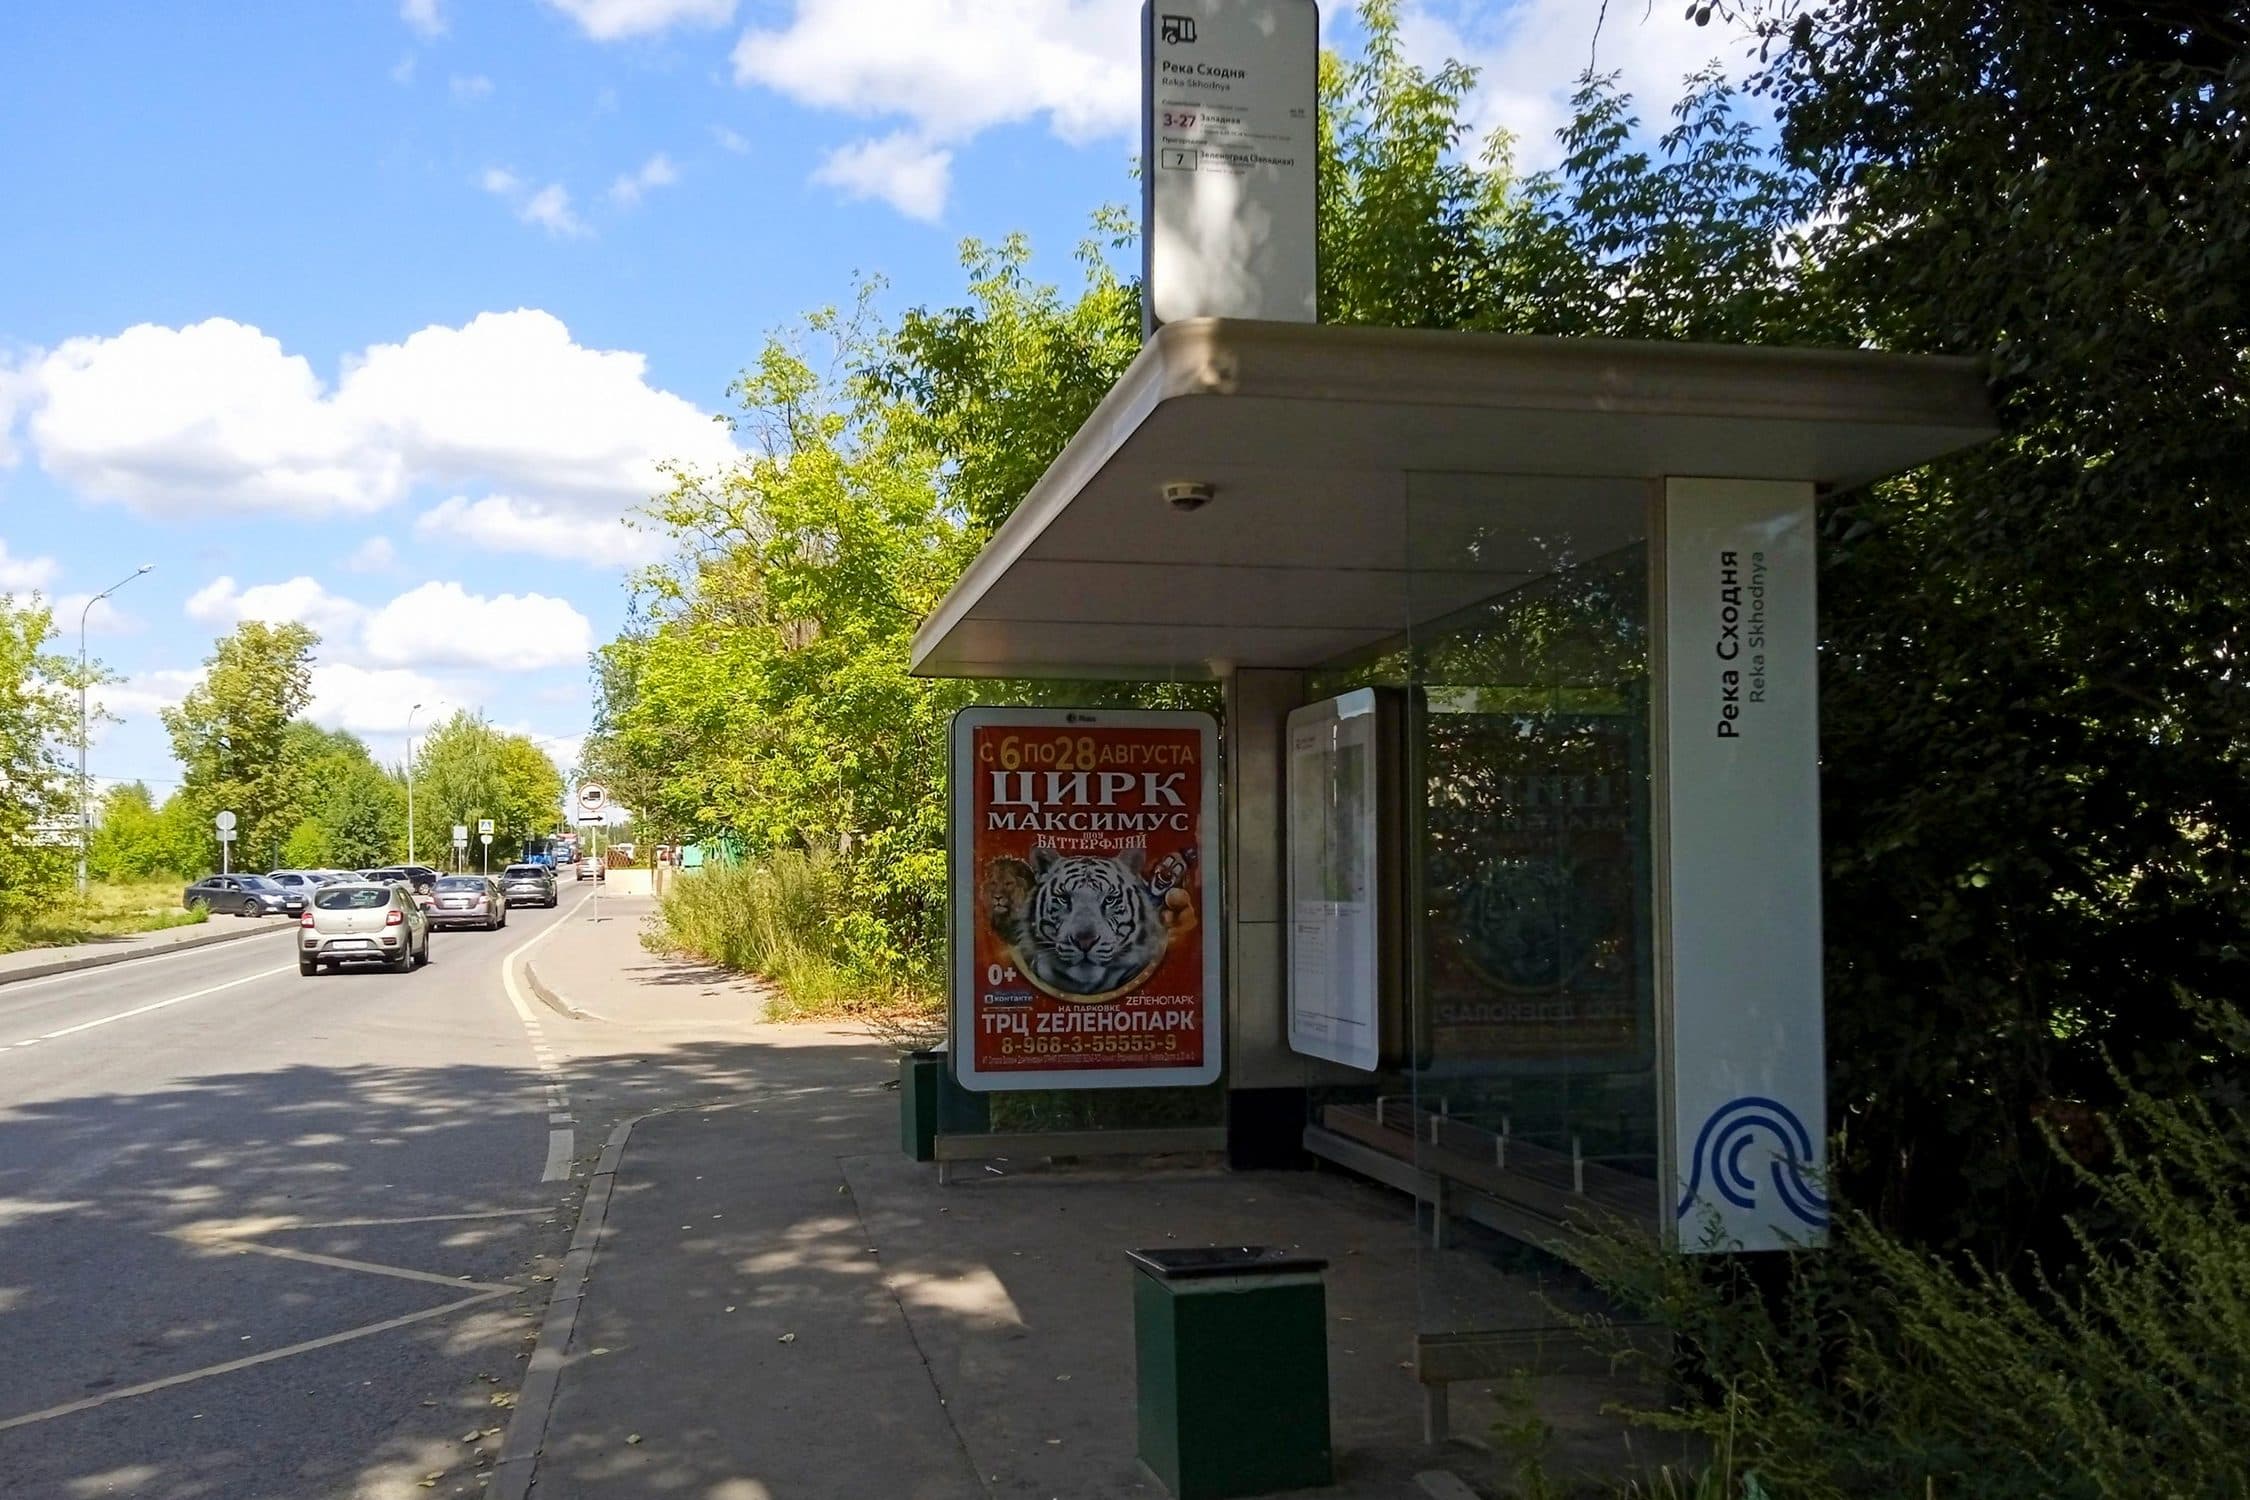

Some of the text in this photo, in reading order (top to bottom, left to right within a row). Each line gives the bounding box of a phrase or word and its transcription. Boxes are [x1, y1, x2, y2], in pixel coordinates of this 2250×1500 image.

[1162, 60, 1246, 80] Река Сходня
[1162, 78, 1231, 92] Reka Skhodnya
[1163, 113, 1196, 128] 3-27
[1176, 153, 1184, 166] 7
[1201, 151, 1249, 163] Зеленоград
[1748, 551, 1768, 703] Reka Skhodnya
[1716, 551, 1742, 738] Река Сходня
[1000, 736, 1021, 771] 6
[1024, 743, 1055, 763] ПО
[1055, 736, 1097, 771] 28
[1099, 744, 1195, 766] АВГУСТА
[989, 770, 1186, 814] ЦИРК
[987, 812, 1189, 832] МАКСИМУС
[1036, 832, 1148, 850] БАТТЕРФЛЯЙ
[987, 963, 1017, 986] 0+
[1073, 1003, 1121, 1013] ПАРКОВКЕ
[982, 1010, 1195, 1036] ТРЦ ZЕЛЕНОПАРК
[1001, 1033, 1177, 1055] 8-968-3-55555-9
